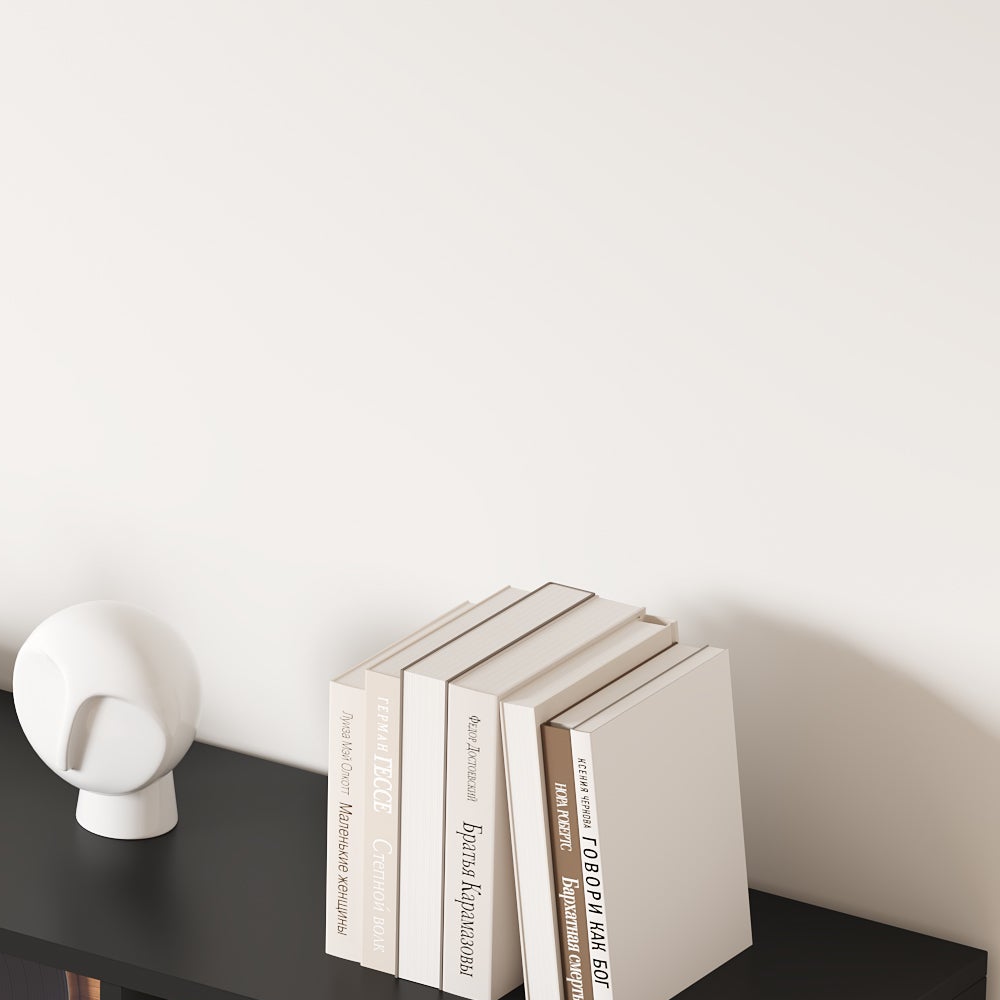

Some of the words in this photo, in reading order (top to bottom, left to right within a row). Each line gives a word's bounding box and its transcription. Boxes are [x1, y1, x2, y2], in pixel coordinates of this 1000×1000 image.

[340, 710, 353, 739] Луиза
[377, 697, 389, 752] ГЕРМАН
[341, 740, 352, 761] Мэй
[340, 762, 353, 796] Олкотт
[373, 754, 393, 814] ГЕССЕ
[555, 782, 568, 807] НОРА
[577, 757, 589, 793] КСЕНИЯ
[558, 809, 572, 852] РОБЕРТС
[580, 794, 592, 829] ЧЕРНОВА
[338, 802, 353, 873] Маленькие
[456, 821, 483, 878] Братья
[372, 838, 392, 913] Степной
[582, 836, 603, 915] ГОВОРИ
[336, 874, 349, 936] женщины
[559, 876, 580, 952] Бархатная
[372, 916, 385, 953] волк
[455, 880, 482, 978] Карамазовы
[589, 919, 607, 952] КАК
[592, 958, 610, 989] БОГ
